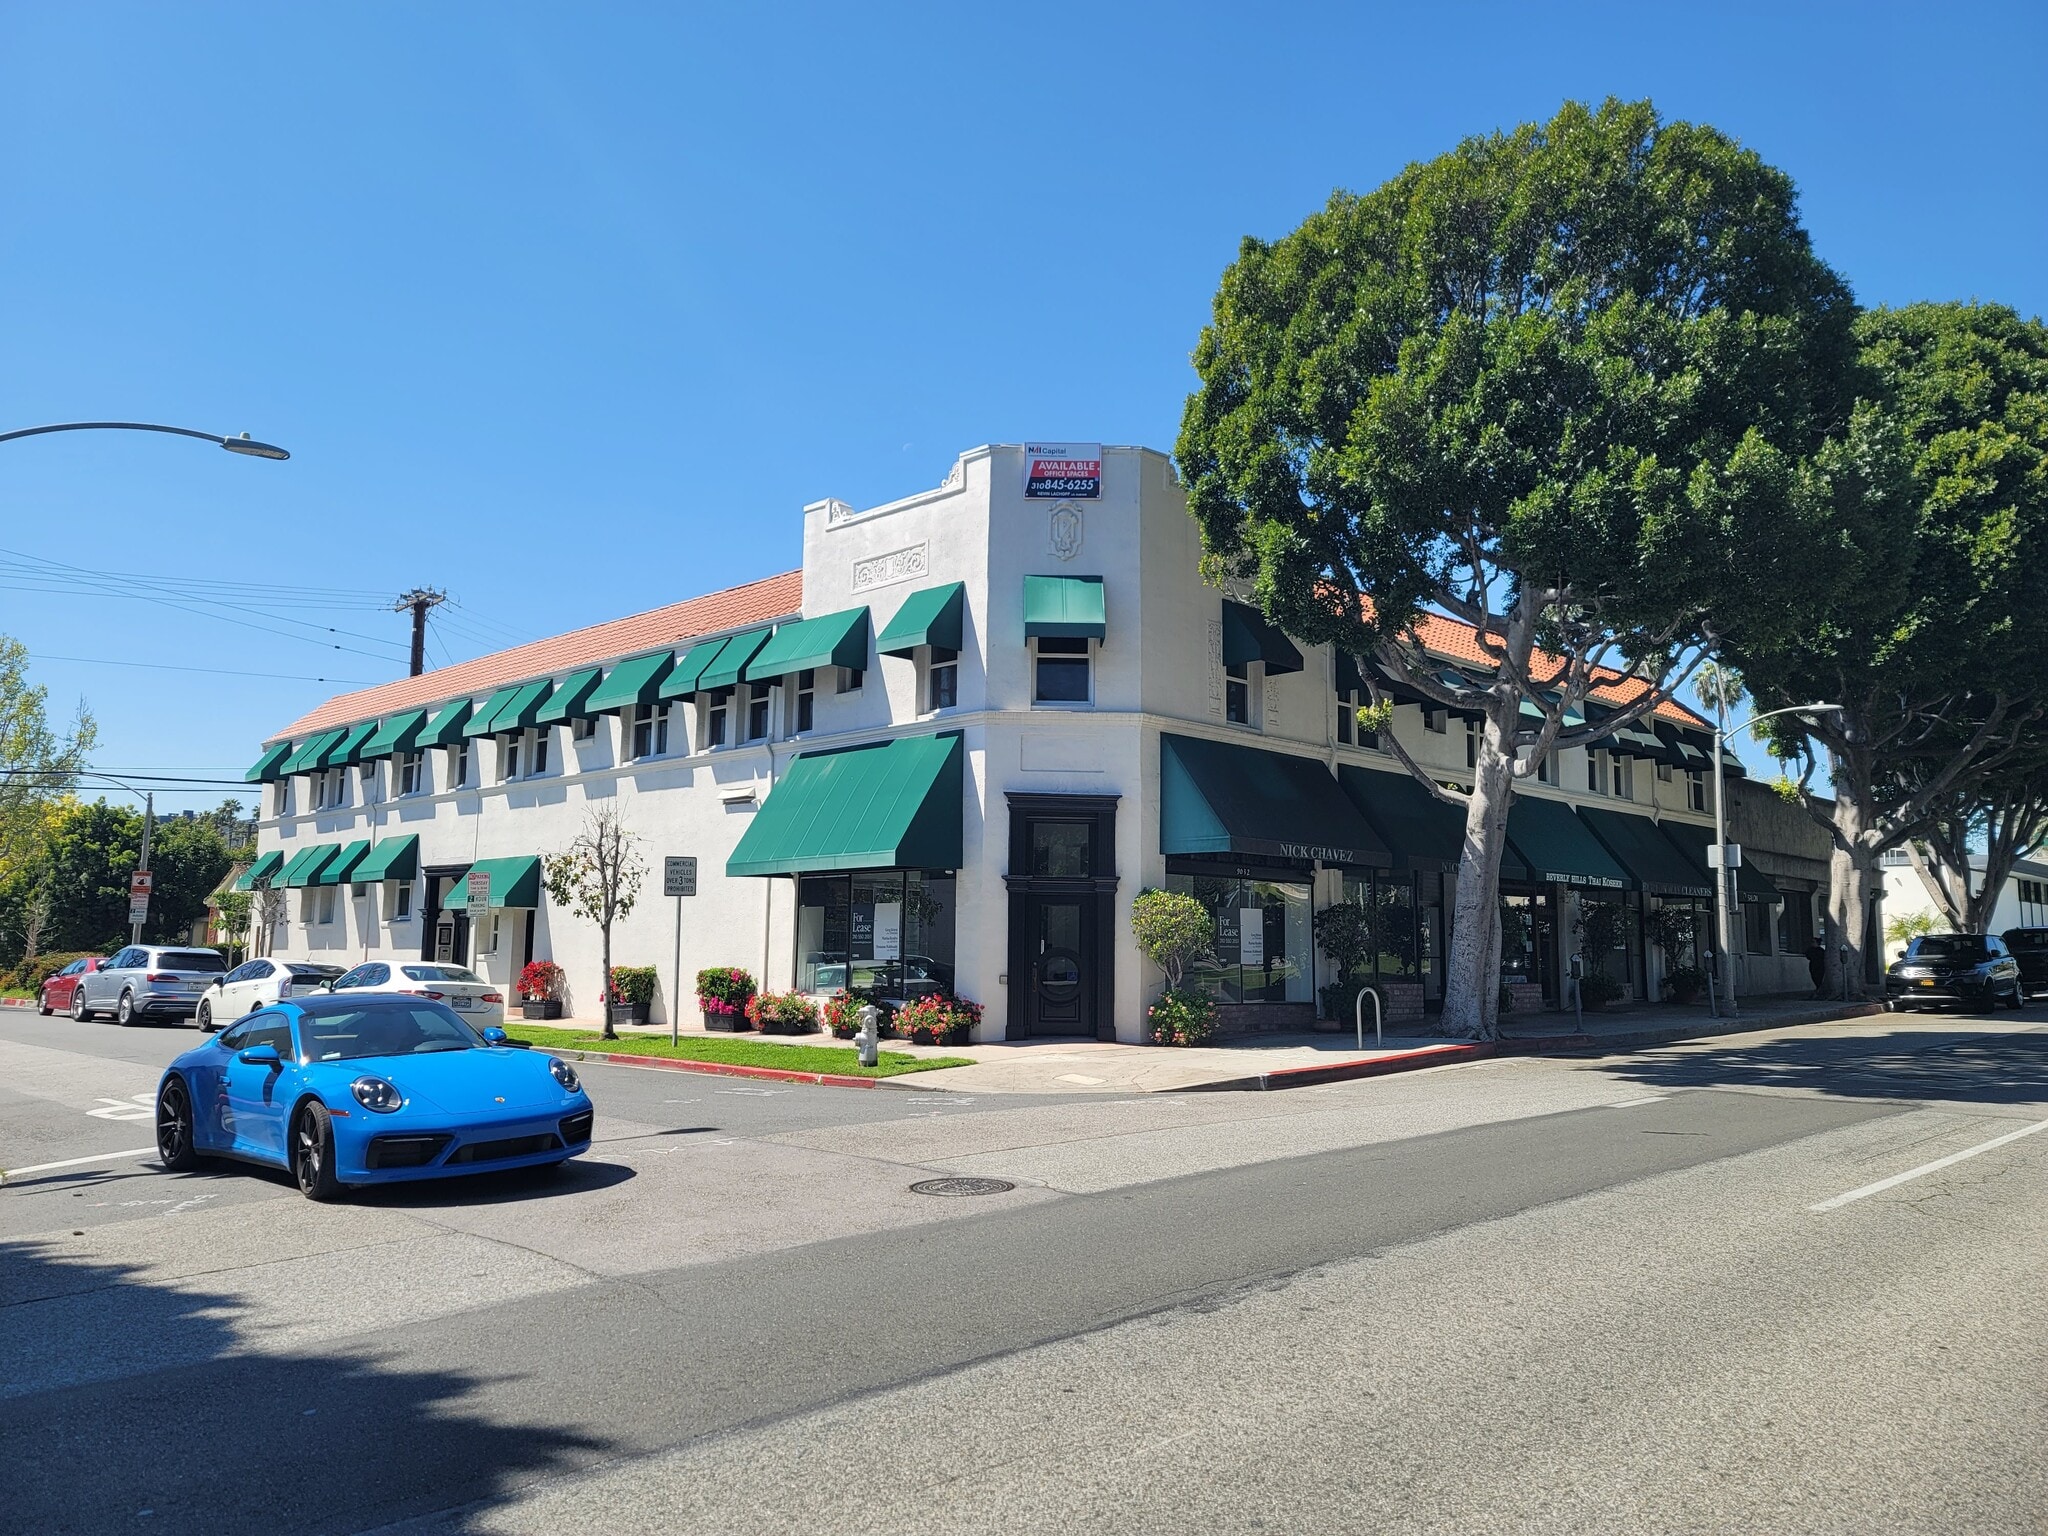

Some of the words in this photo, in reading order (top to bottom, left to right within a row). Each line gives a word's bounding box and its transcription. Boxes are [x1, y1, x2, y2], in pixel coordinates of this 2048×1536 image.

[1042, 447, 1066, 455] Capital
[1038, 462, 1095, 470] AVAILABLE
[1280, 843, 1309, 858] NICK
[1310, 846, 1353, 862] CHAVEZ
[1441, 861, 1459, 873] NIC
[679, 876, 684, 885] 3
[1546, 872, 1570, 882] BEVERLY
[1571, 875, 1586, 884] HILLS
[1681, 886, 1712, 896] CLEANERS
[853, 913, 864, 922] For
[1220, 916, 1230, 926] For
[853, 923, 871, 932] Lease
[1220, 927, 1239, 937] Lease
